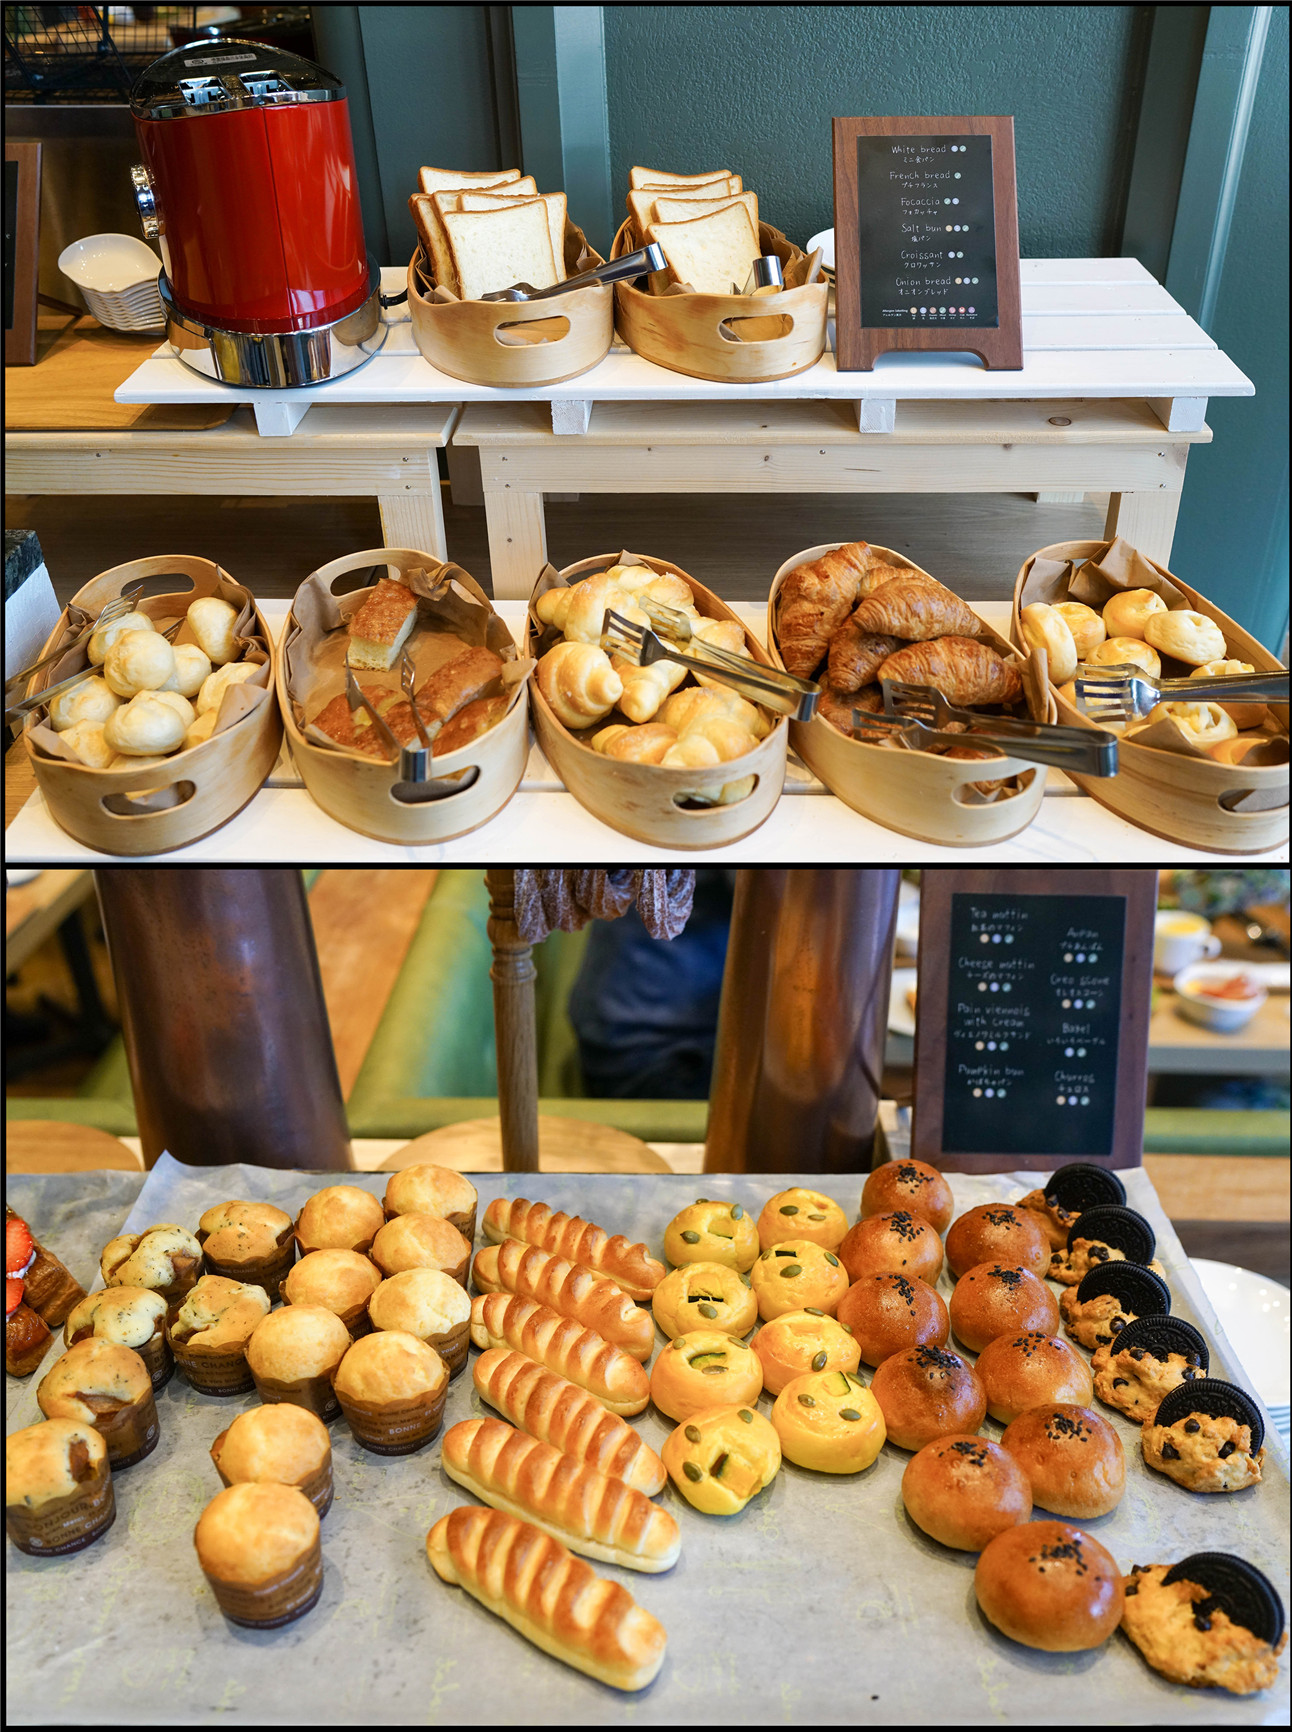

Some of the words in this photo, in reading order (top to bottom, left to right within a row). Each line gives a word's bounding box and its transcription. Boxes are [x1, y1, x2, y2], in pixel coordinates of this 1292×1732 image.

[891, 145, 916, 155] White
[920, 144, 947, 154] bread
[889, 171, 920, 180] French
[924, 170, 951, 179] bread
[900, 197, 940, 206] Focaccia
[901, 222, 920, 233] Salt
[925, 223, 942, 232] bun
[900, 250, 943, 260] Croissant
[895, 276, 921, 287] Onion
[925, 276, 952, 285] bread
[958, 956, 994, 969] Cheese
[957, 1002, 981, 1014] Pain
[963, 1016, 987, 1027] with
[389, 1422, 422, 1436] BONNE
